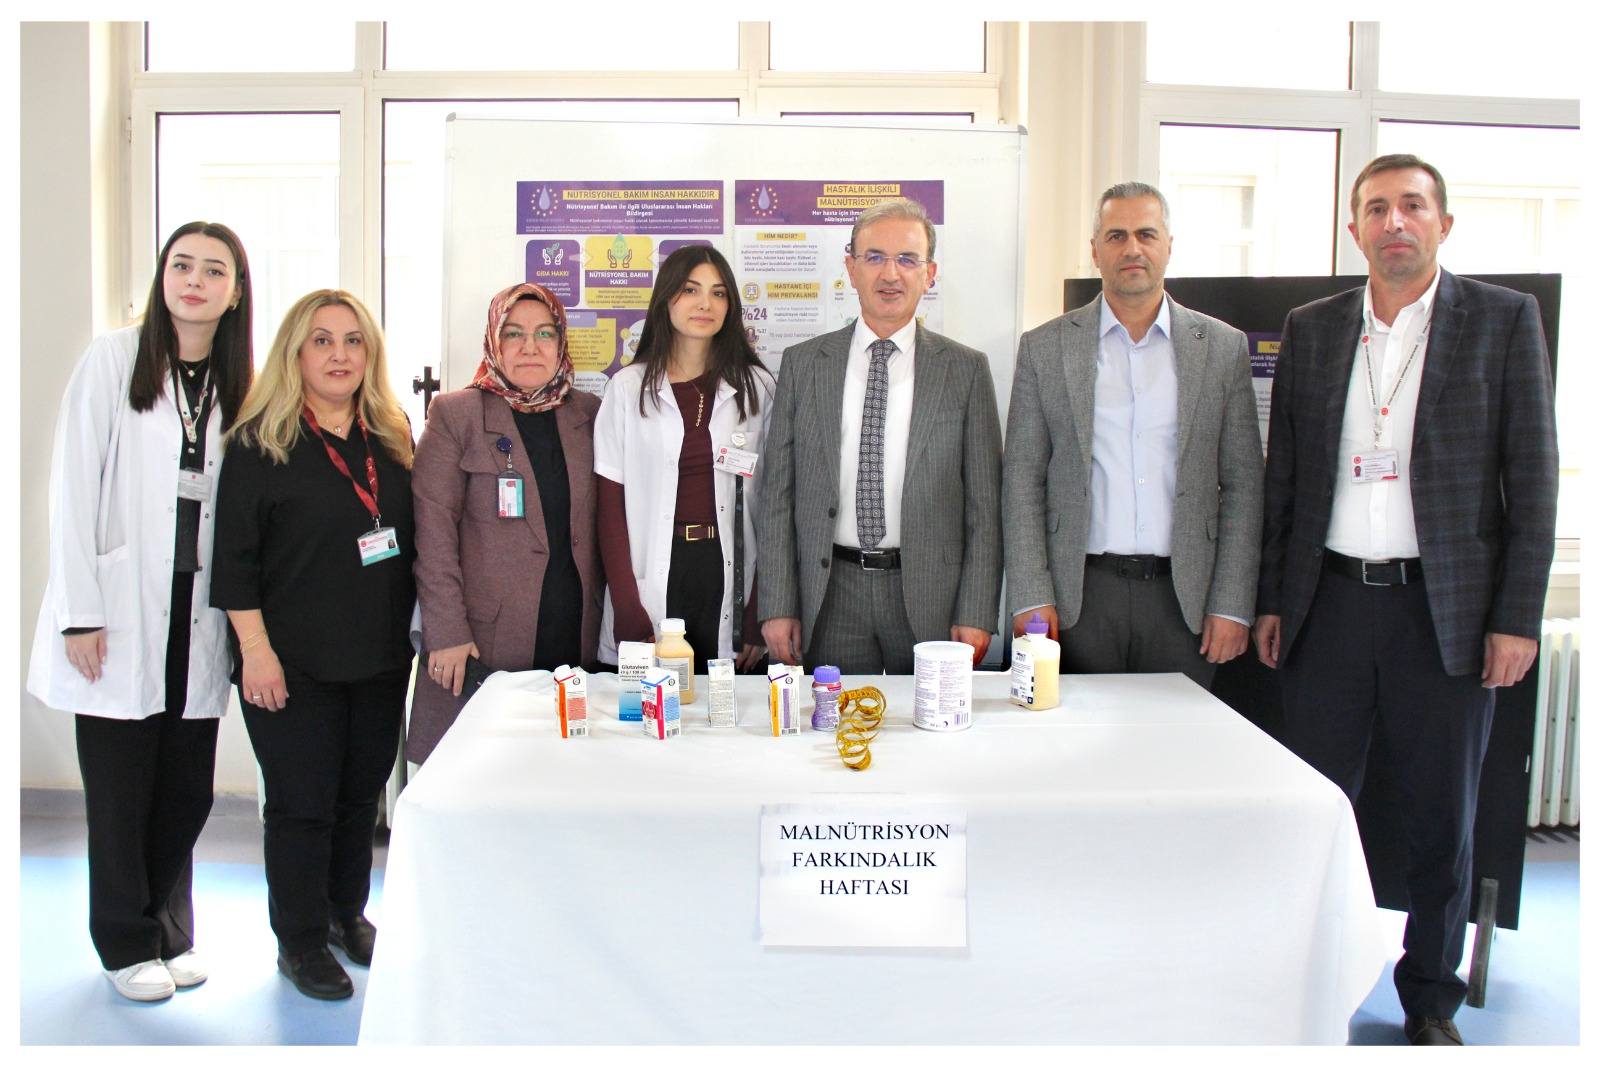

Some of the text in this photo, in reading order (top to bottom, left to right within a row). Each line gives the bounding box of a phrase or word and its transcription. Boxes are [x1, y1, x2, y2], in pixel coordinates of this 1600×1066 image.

[567, 190, 715, 199] NÜTRİSYONEL BAKIM İNSAN HAKKIDIR
[826, 184, 897, 194] HASTALIK İLİŞKİLİ
[780, 822, 950, 840] MALNÜTRİSYON
[792, 852, 937, 868] FARKINDALIK
[820, 880, 910, 895] HAFTASI
